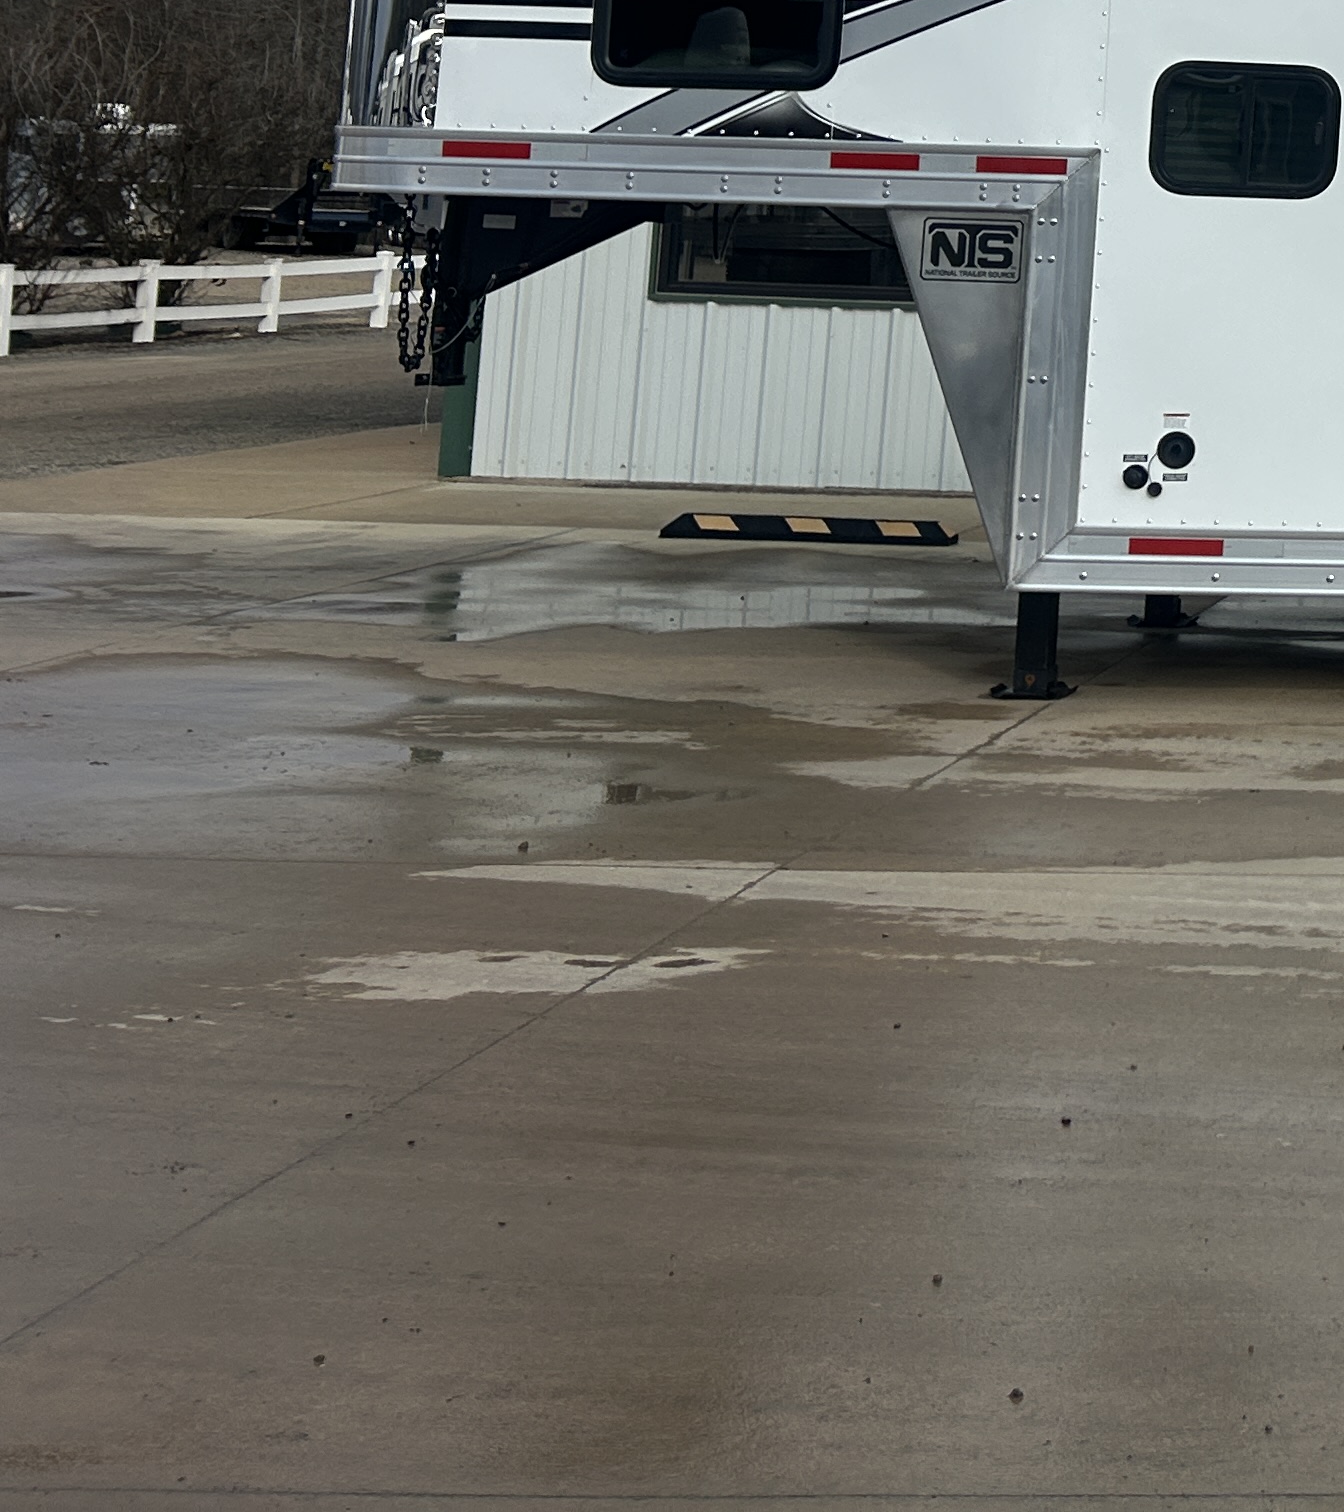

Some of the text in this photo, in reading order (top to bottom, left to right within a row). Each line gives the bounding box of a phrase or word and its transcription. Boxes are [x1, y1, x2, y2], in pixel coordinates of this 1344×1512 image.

[928, 222, 1019, 268] NTS
[925, 269, 1016, 279] NATIONAL TRAILER SOURCE
